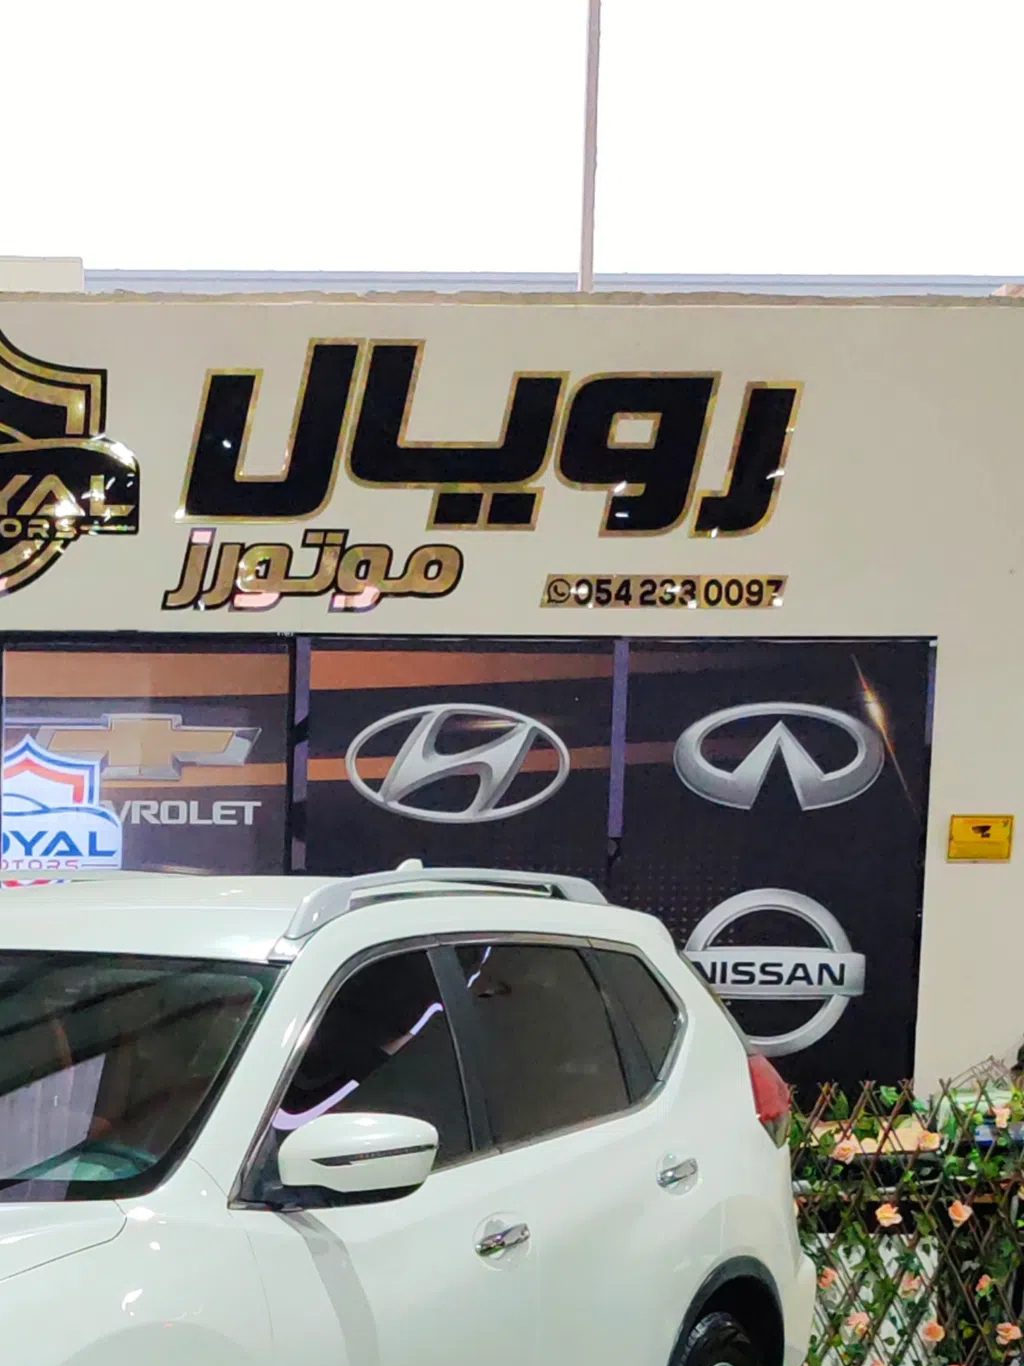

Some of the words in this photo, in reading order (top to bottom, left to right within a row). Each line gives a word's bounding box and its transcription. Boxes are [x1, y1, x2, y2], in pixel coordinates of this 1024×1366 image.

[174, 336, 805, 538] رويال
[161, 528, 464, 613] موتورز
[574, 578, 633, 606] 054
[639, 578, 697, 606] 233
[691, 961, 846, 986] NISSAN
